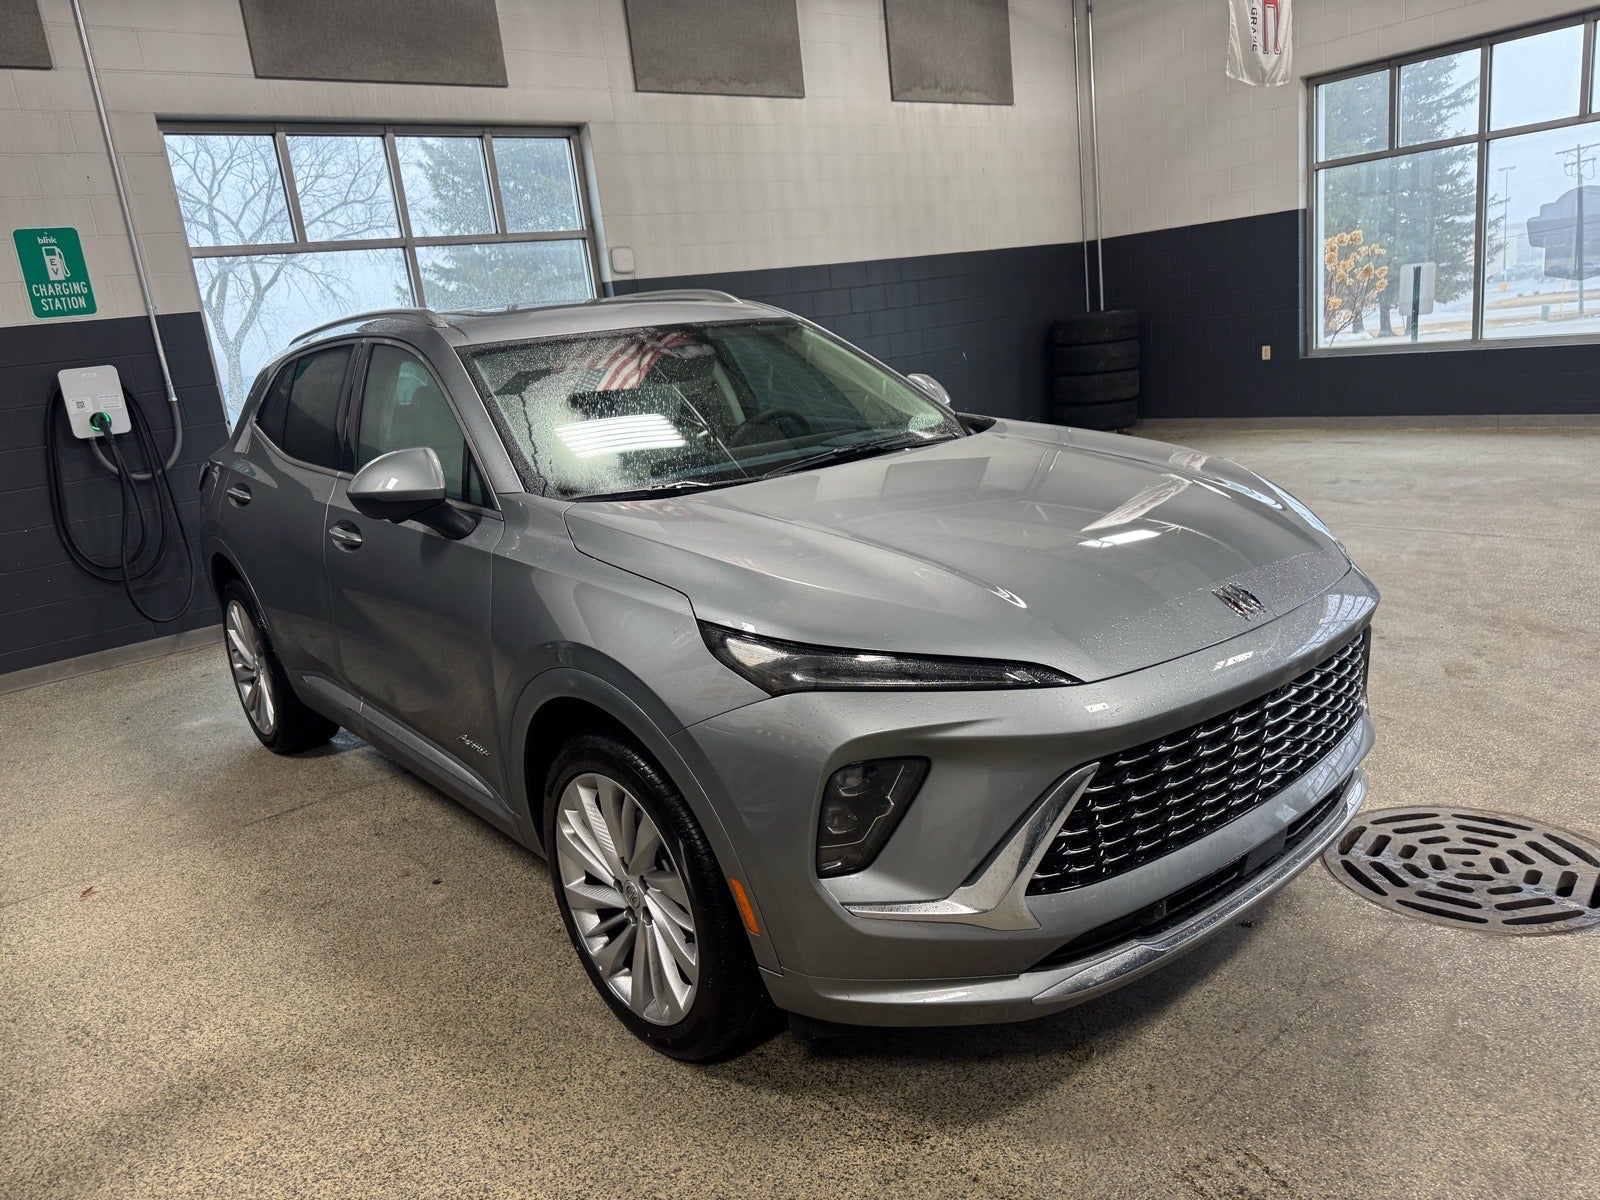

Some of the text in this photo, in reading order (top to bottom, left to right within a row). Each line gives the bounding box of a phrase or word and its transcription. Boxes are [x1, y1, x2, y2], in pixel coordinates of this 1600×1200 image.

[37, 236, 57, 244] blink
[32, 281, 88, 297] CHARGING
[41, 296, 87, 311] STATION
